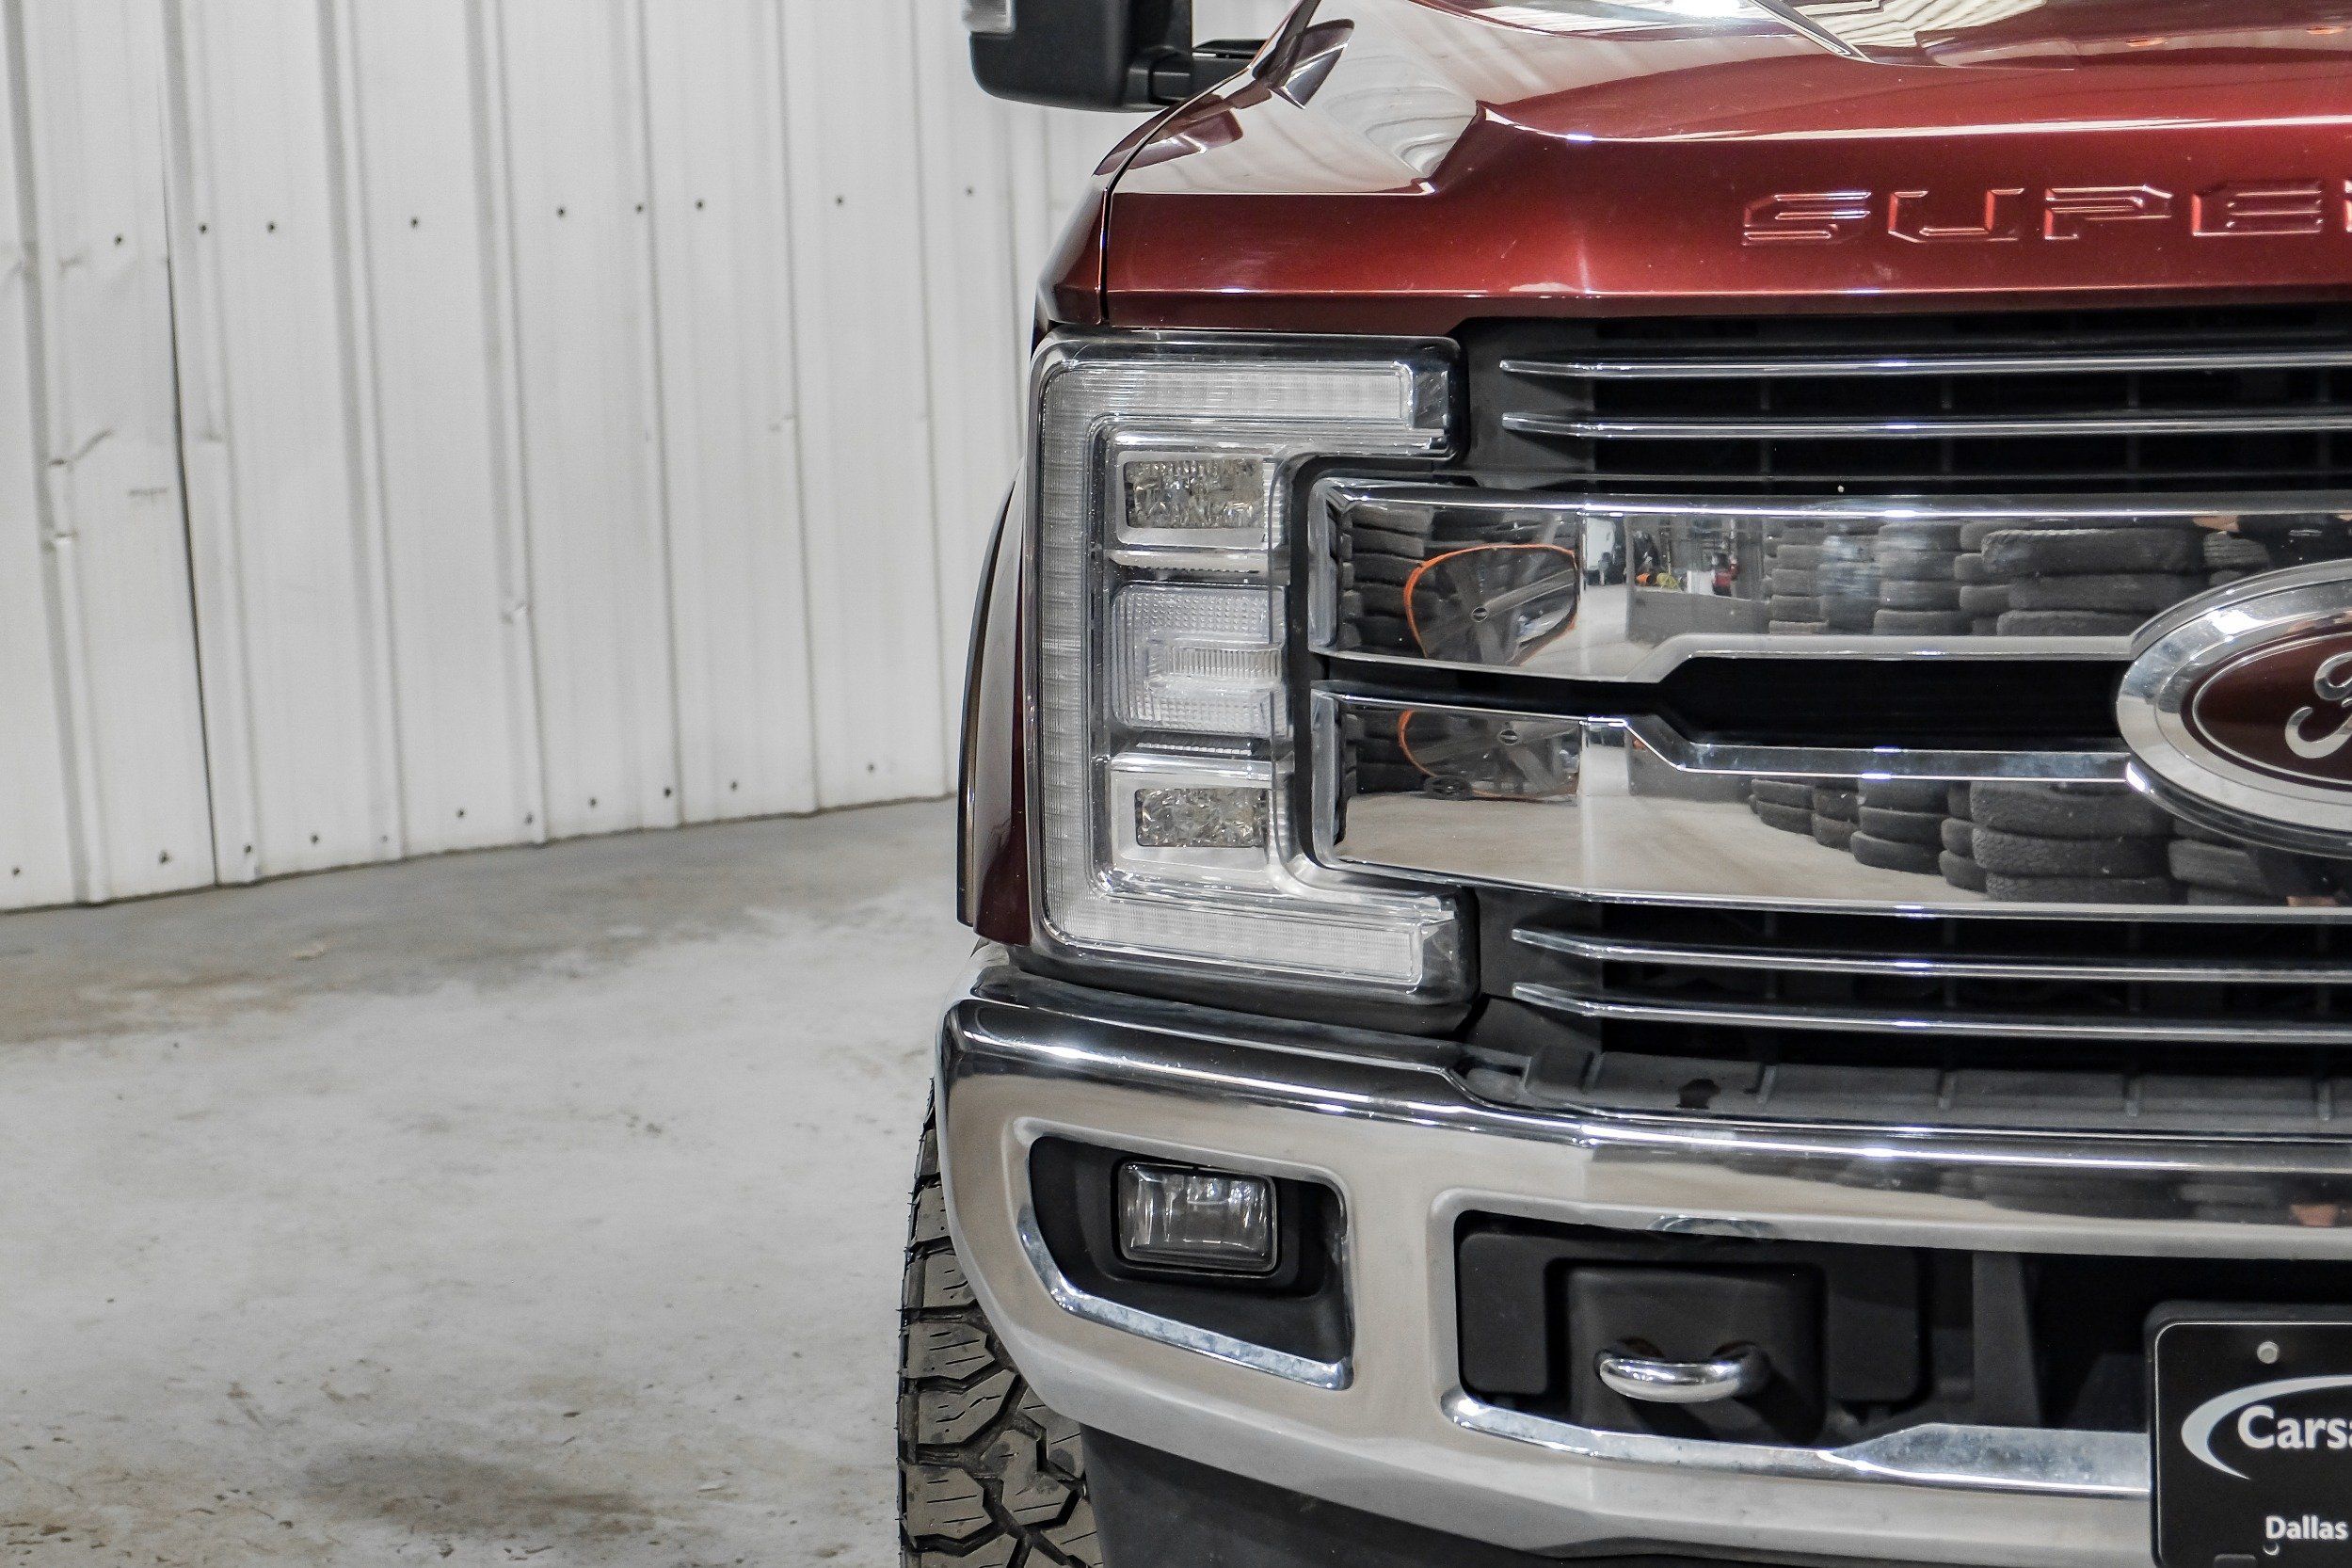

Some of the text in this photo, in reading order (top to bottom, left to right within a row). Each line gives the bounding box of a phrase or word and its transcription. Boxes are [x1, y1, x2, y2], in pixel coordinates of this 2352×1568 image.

[1741, 180, 2352, 246] SUPE
[2237, 1404, 2352, 1450] Cars
[2264, 1513, 2349, 1541] Dallas
